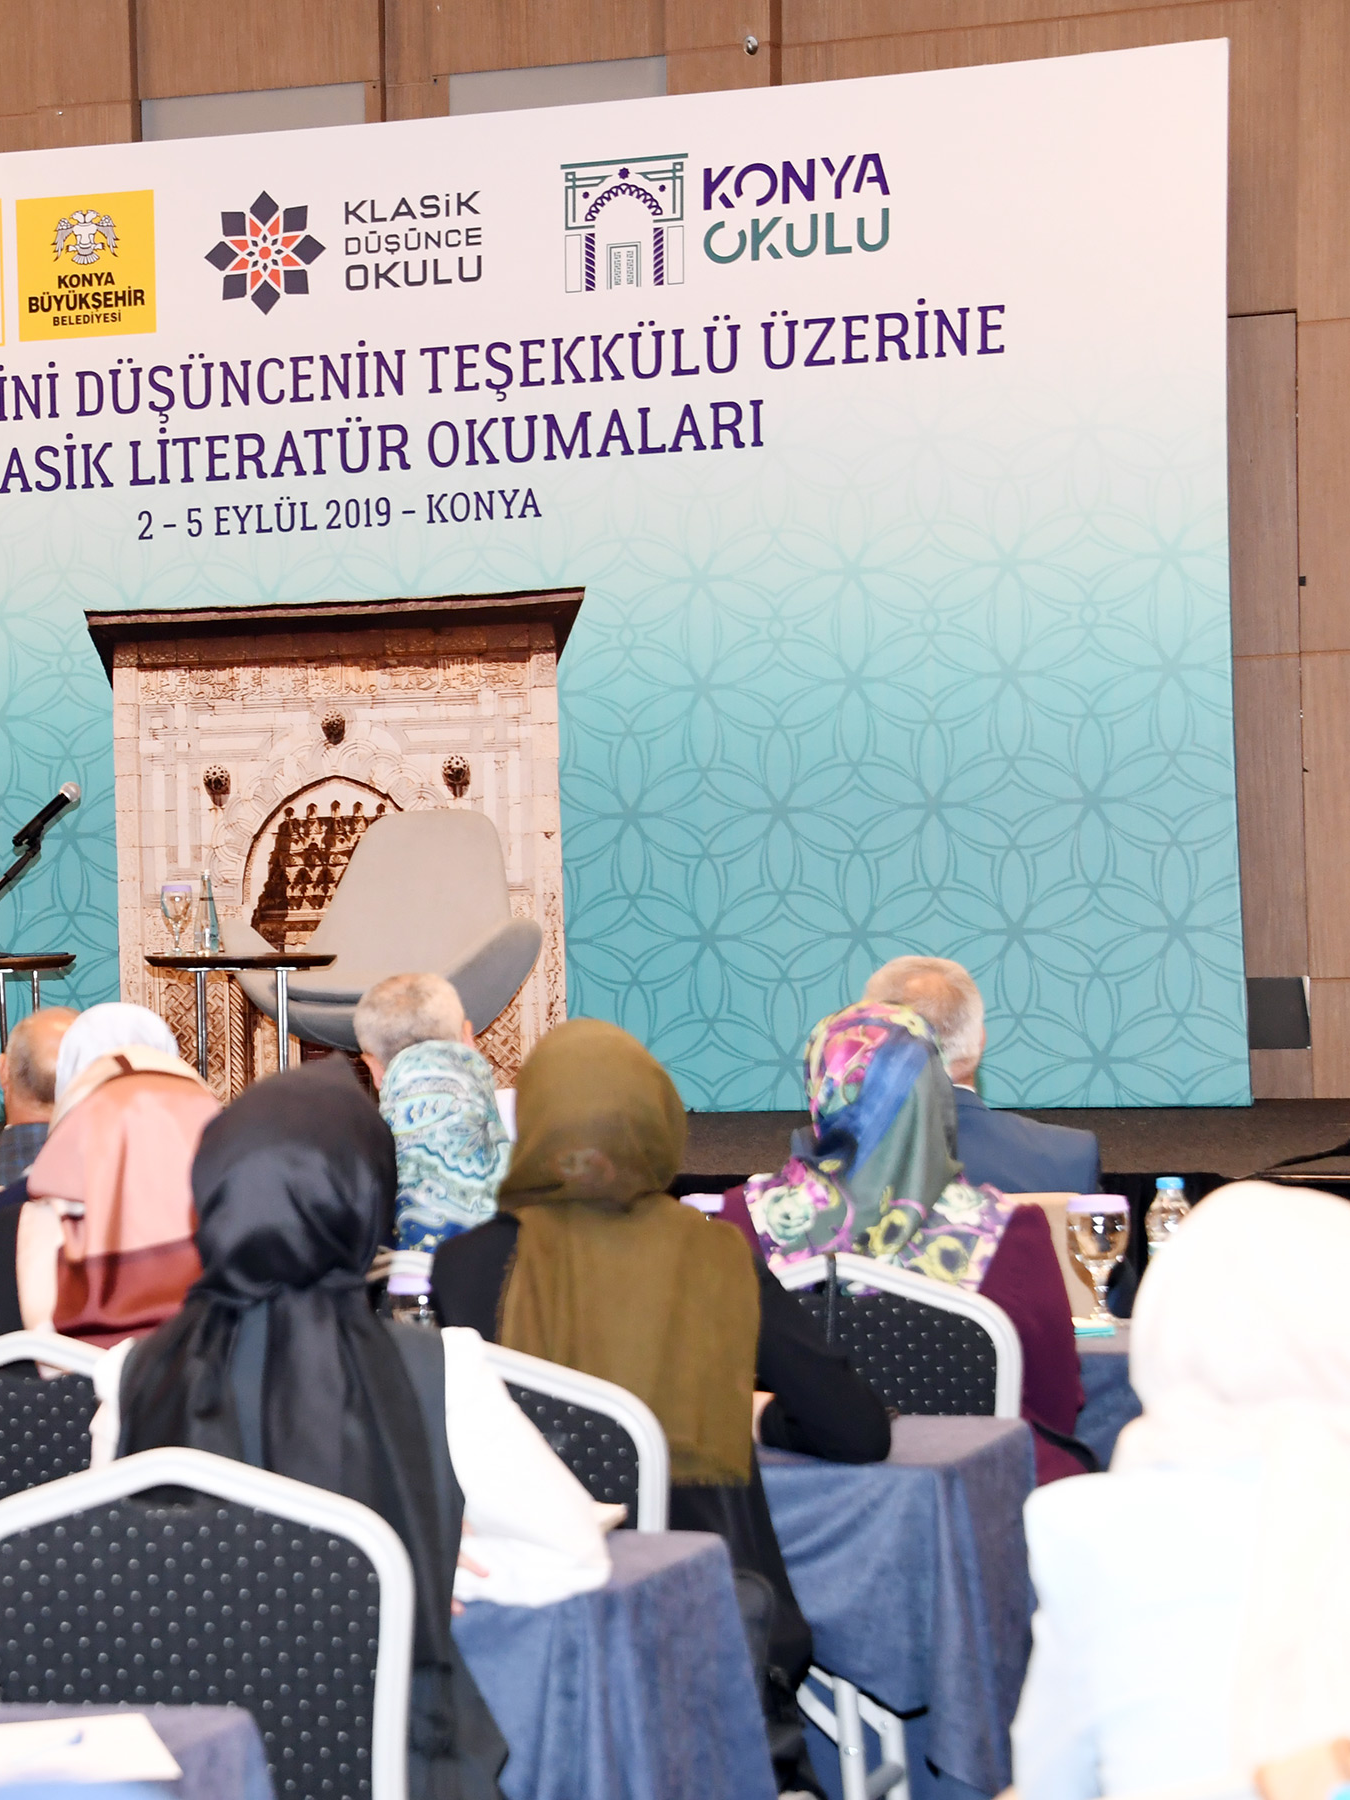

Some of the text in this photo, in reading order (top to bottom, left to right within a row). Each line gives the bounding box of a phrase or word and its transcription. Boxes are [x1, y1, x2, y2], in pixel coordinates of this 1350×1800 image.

[703, 153, 890, 210] KONYA
[704, 208, 889, 264] OKULU
[57, 271, 116, 289] KONYA
[345, 254, 482, 292] OKULU
[28, 286, 145, 314] BÜYÜKŞEHİR
[52, 312, 122, 327] BELEDİYESİ
[75, 339, 407, 425] DÜŞÜNCENİN
[419, 314, 742, 403] TEŞEKKÜLÜ
[760, 297, 1006, 370] ÜZERİNE
[129, 415, 411, 487] LİTERATÜR
[427, 398, 764, 469] OKUMALARI
[137, 511, 154, 541] 2
[187, 507, 203, 538] 5
[214, 496, 318, 537] EYLÜL
[325, 496, 391, 530] 2019
[426, 488, 542, 524] KONYA
